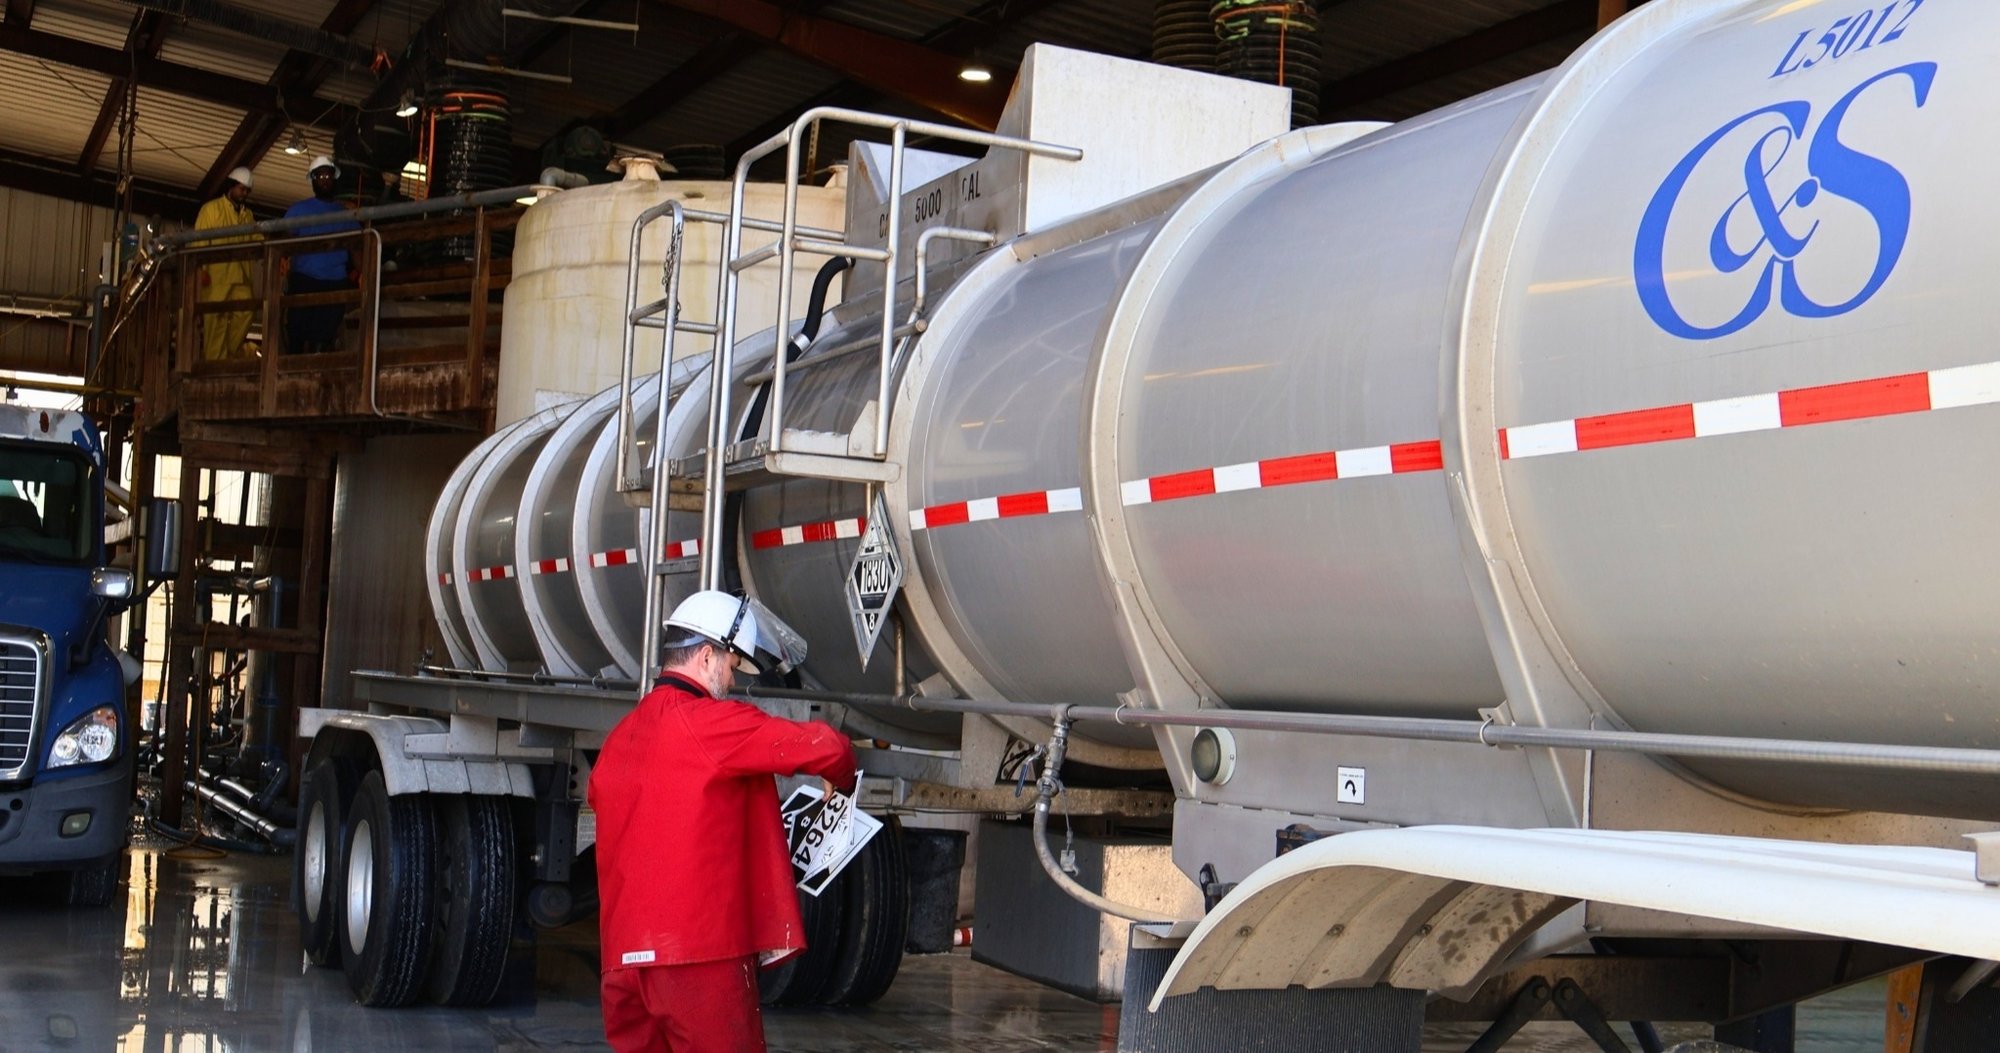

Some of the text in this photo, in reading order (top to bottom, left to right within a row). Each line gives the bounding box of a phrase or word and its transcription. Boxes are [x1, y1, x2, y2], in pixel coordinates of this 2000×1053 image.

[1768, 0, 1924, 79] L5012
[915, 188, 942, 223] 5000
[863, 559, 887, 592] 1830
[869, 612, 875, 630] 8
[794, 794, 845, 866] 3264
